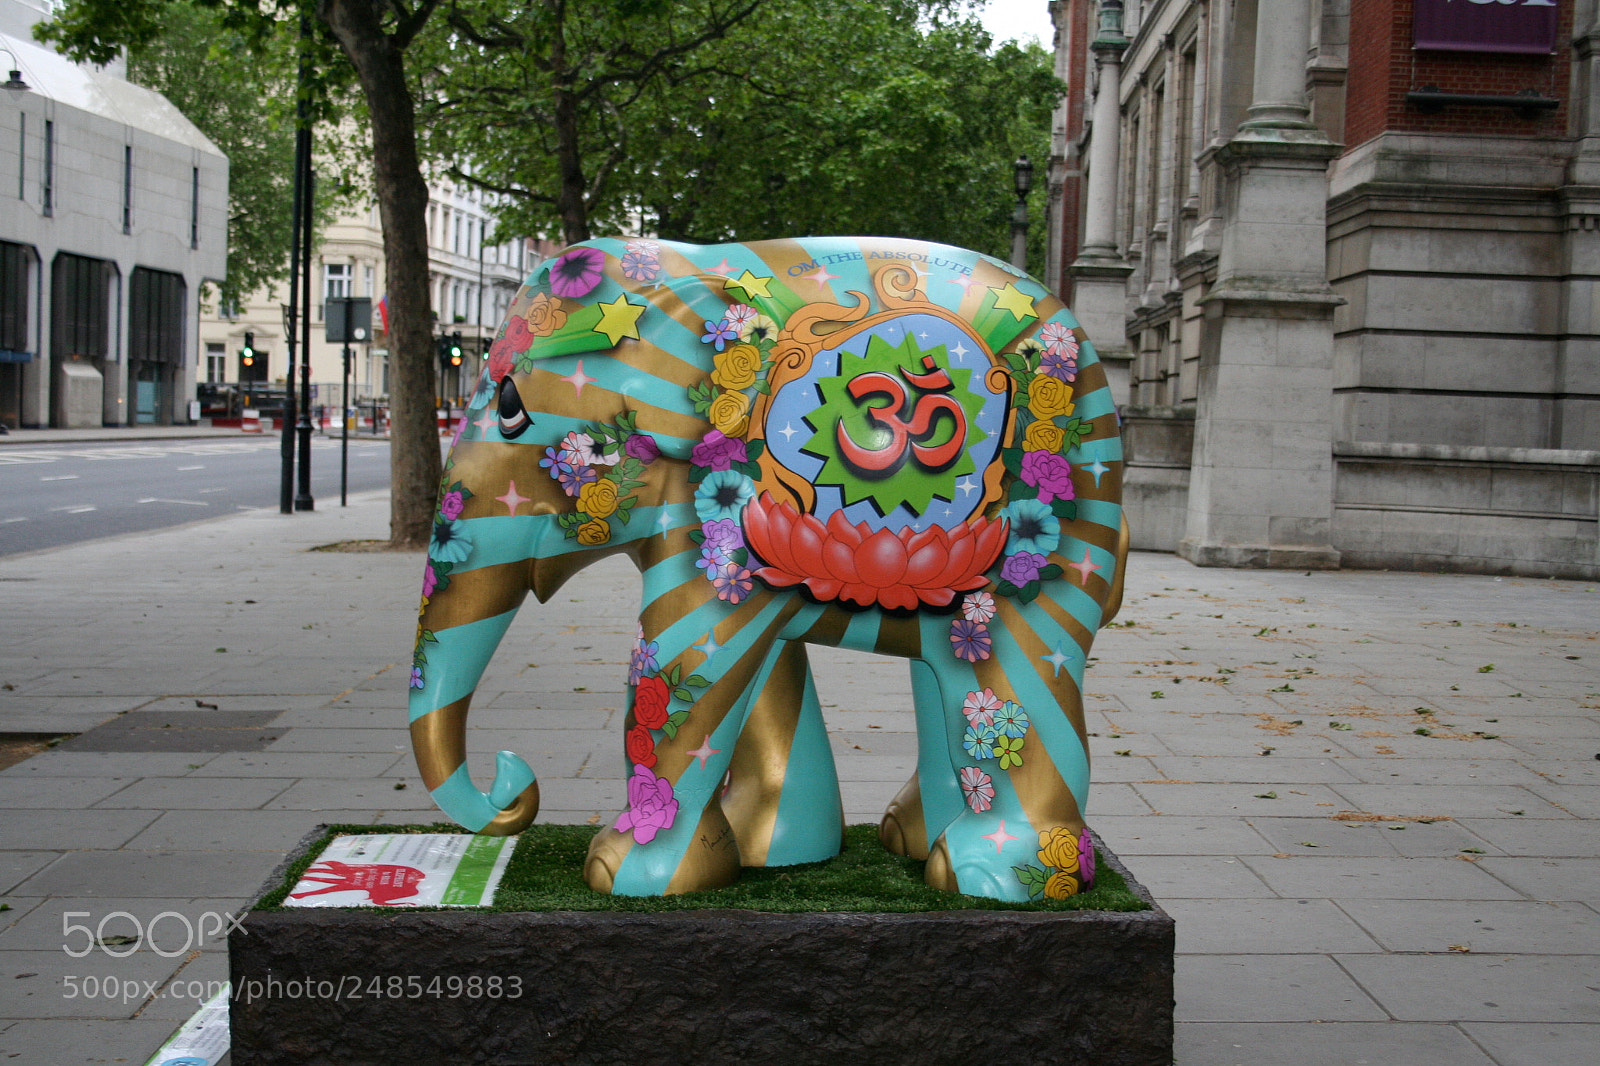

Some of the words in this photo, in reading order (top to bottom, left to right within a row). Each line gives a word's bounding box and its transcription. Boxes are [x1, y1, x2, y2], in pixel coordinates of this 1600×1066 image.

[787, 258, 820, 277] OM
[822, 251, 863, 266] THE
[868, 250, 974, 277] ABSOLUTE
